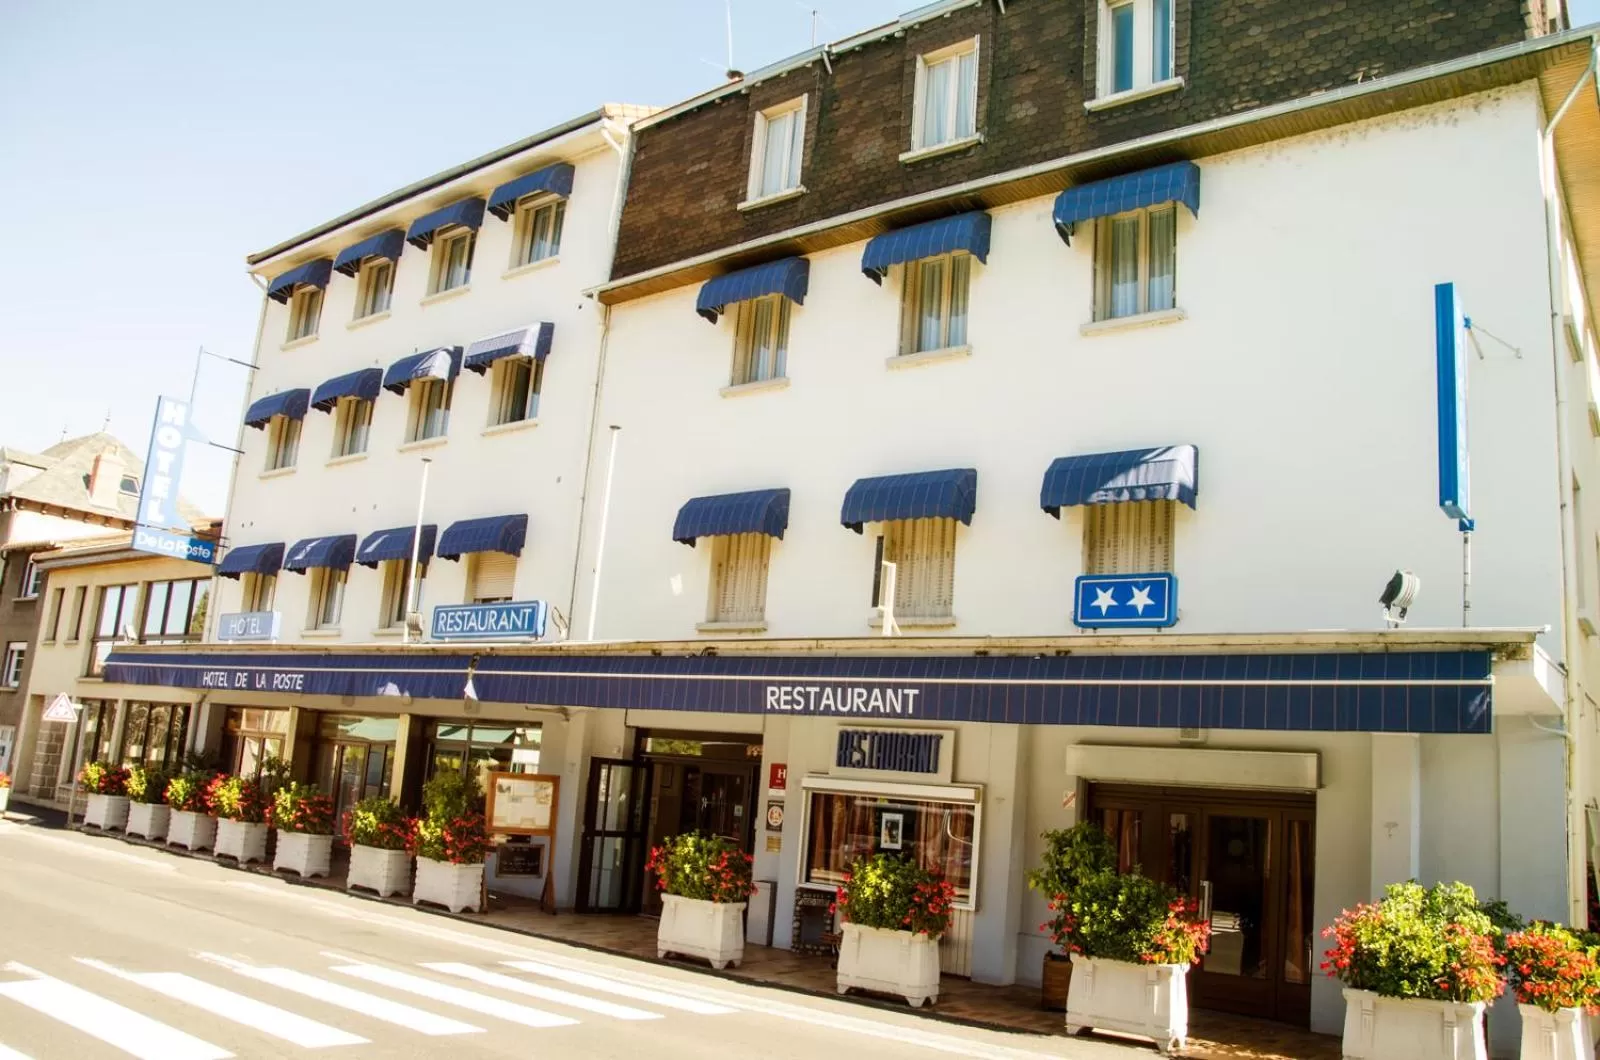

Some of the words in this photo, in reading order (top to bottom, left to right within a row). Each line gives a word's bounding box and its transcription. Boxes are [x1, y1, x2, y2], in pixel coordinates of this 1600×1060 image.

[147, 402, 186, 523] HOTEL
[138, 531, 158, 550] De
[160, 537, 175, 552] La
[175, 540, 212, 561] Poste
[229, 617, 262, 636] HOTEL
[438, 610, 532, 632] RESTAURANT
[202, 671, 229, 689] HOTEL
[234, 672, 248, 688] DE
[255, 672, 267, 689] LA
[272, 673, 305, 691] POSTE
[766, 686, 920, 714] RESTAURANT
[837, 730, 943, 773] RESTAURANT
